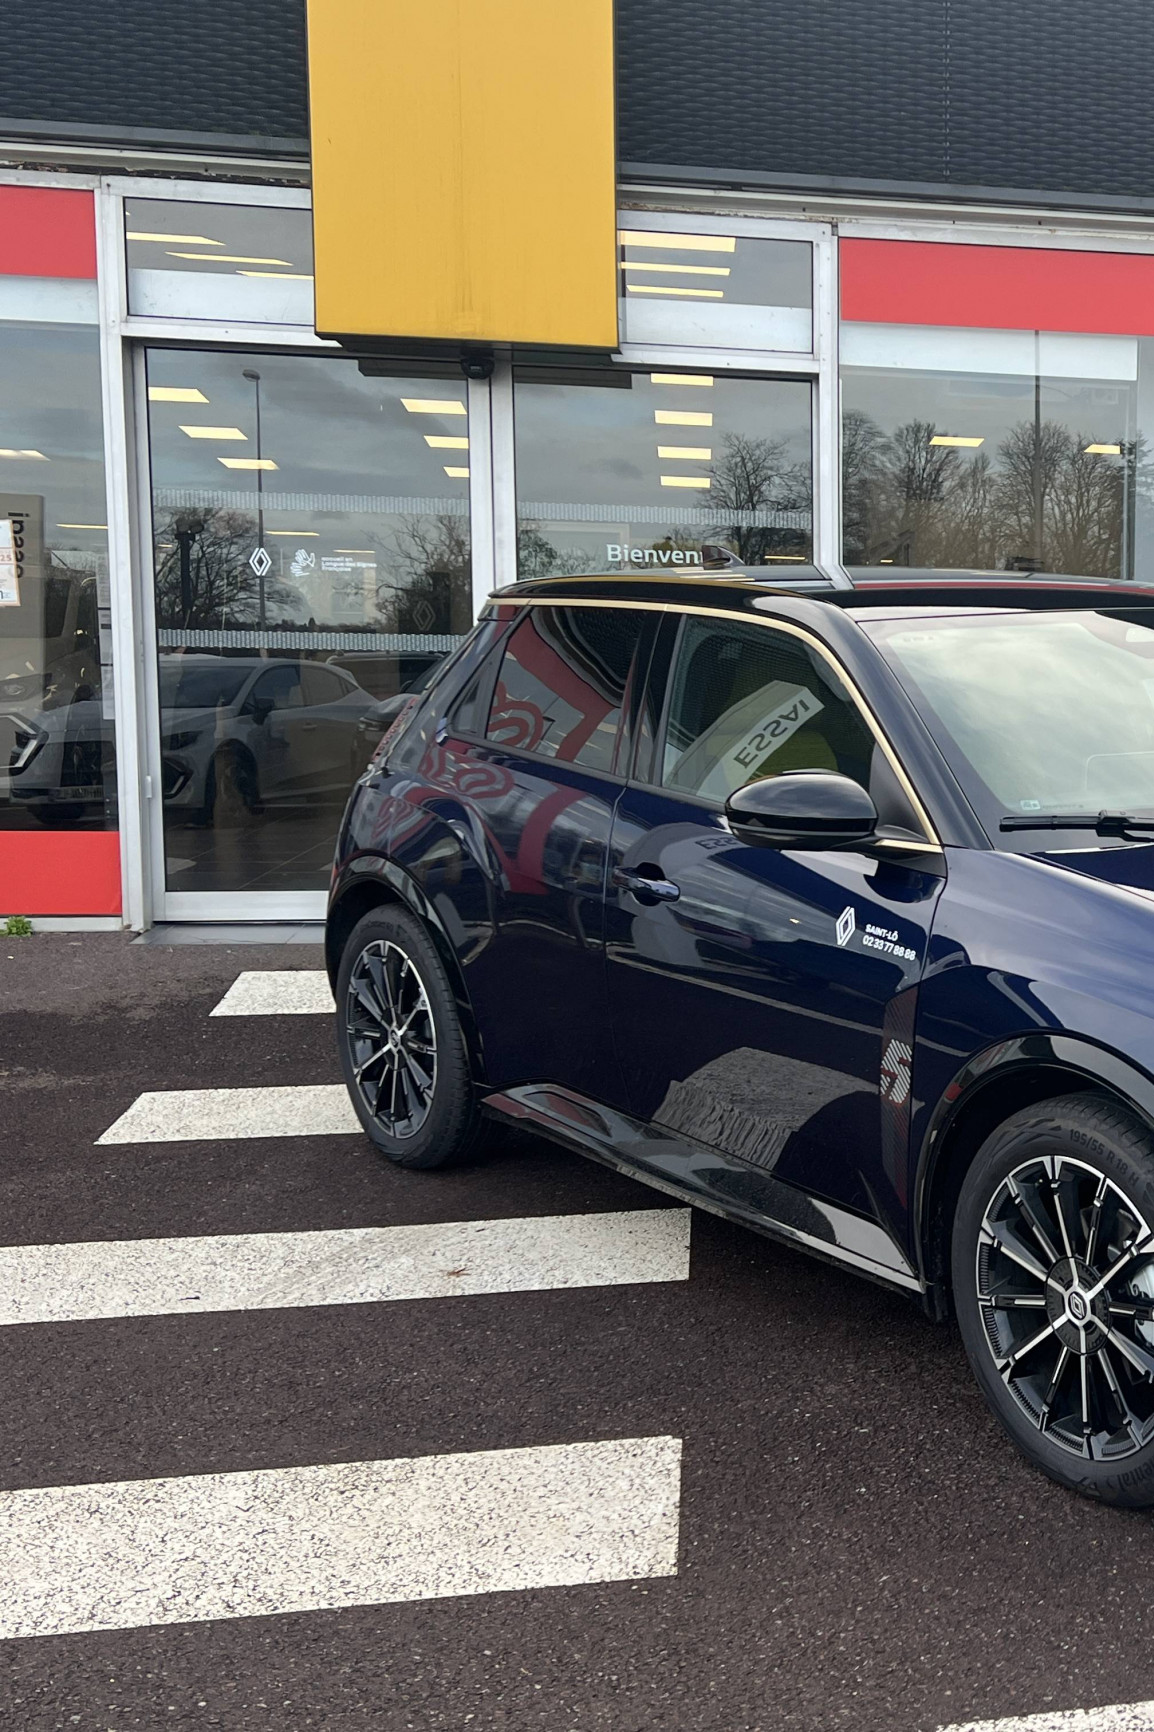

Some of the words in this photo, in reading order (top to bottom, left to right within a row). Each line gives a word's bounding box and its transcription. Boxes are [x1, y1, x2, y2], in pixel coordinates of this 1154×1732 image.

[606, 544, 703, 564] Bienven
[1070, 1129, 1105, 1155] 195/55
[1106, 1150, 1115, 1163] R
[1116, 1159, 1128, 1175] 18
